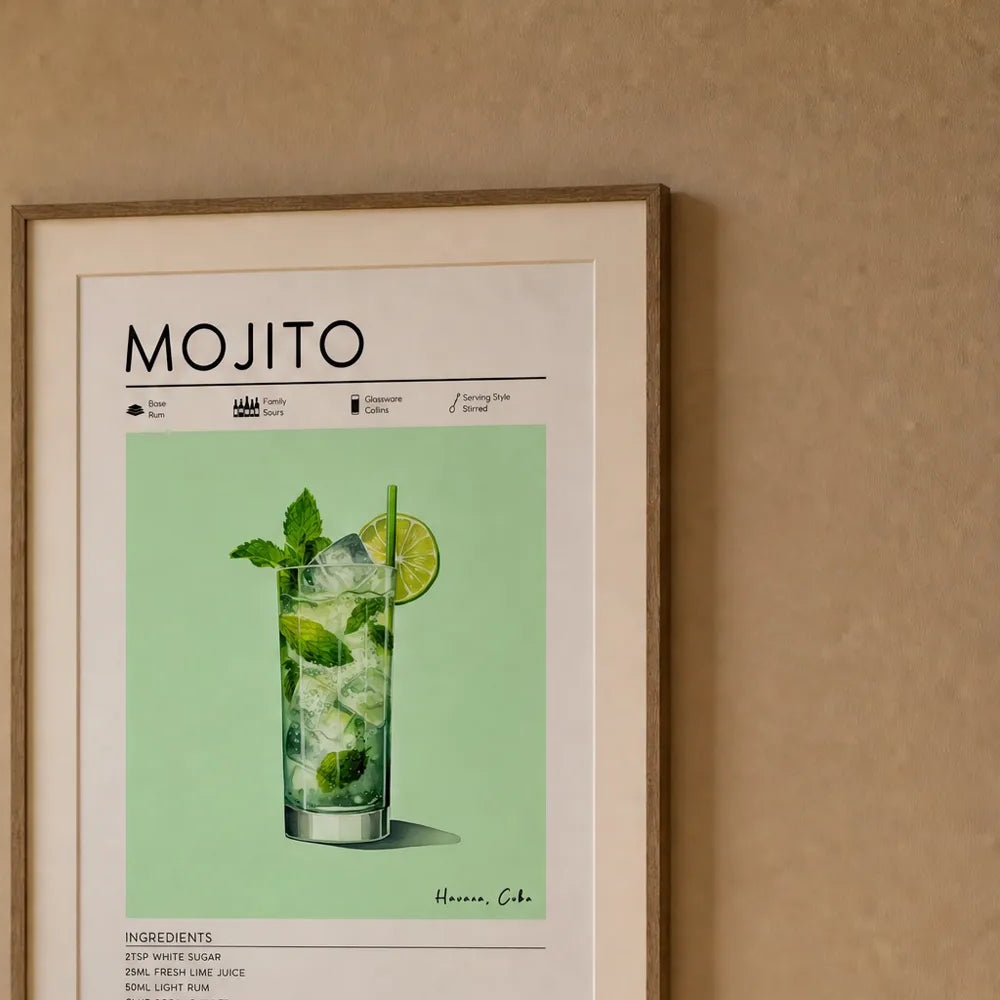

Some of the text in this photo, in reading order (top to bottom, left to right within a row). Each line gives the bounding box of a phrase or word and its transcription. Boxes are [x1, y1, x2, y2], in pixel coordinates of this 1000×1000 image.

[125, 319, 365, 373] MOJITO
[262, 397, 287, 407] Family
[364, 394, 403, 404] Glassware
[462, 392, 511, 404] Serving Style
[148, 399, 167, 408] Base
[462, 404, 489, 413] Stirred
[148, 410, 166, 419] Rum
[262, 408, 285, 417] Sours
[364, 405, 390, 415] Collins
[125, 931, 213, 944] INGREDIENTS
[125, 952, 222, 962] 2TSP WHITE SUGAR
[154, 967, 187, 977] FRESH
[189, 968, 213, 977] LIME
[216, 968, 246, 978] JUICE
[125, 982, 210, 992] 50ML LIGHT RUM
